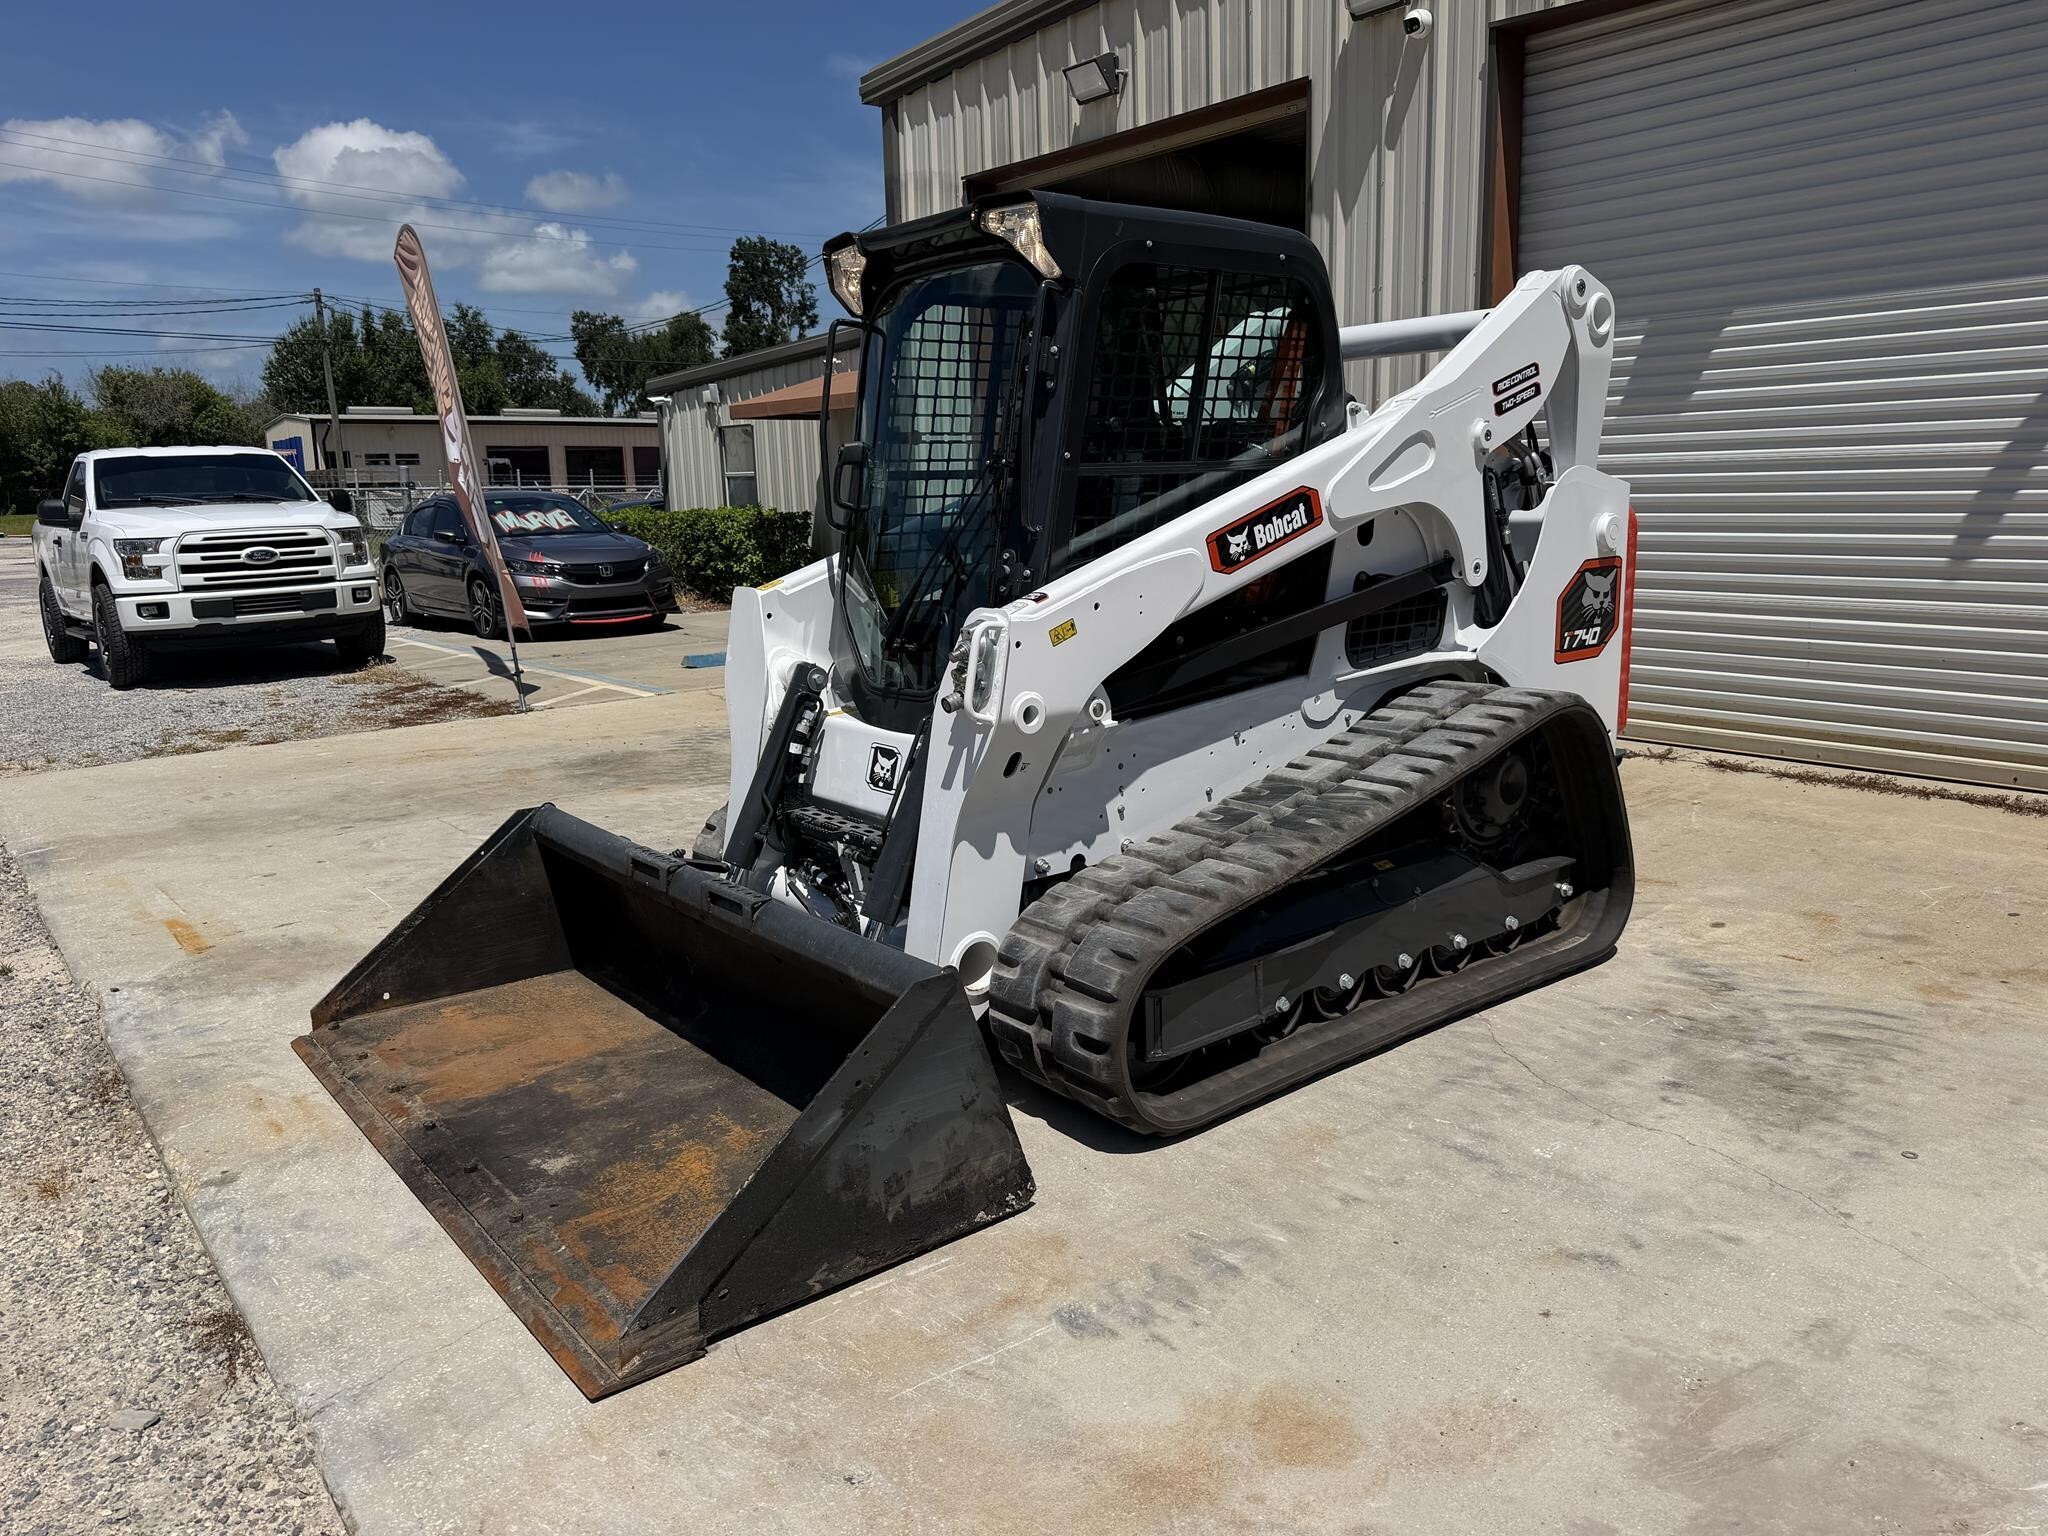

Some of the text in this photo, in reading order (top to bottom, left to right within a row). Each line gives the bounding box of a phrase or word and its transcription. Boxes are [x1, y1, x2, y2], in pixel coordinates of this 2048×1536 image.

[1497, 366, 1537, 392] RIDE CONTROL
[1502, 386, 1536, 411] TWO-SPEED
[1253, 502, 1308, 550] Bobcat
[1563, 626, 1601, 650] T740
